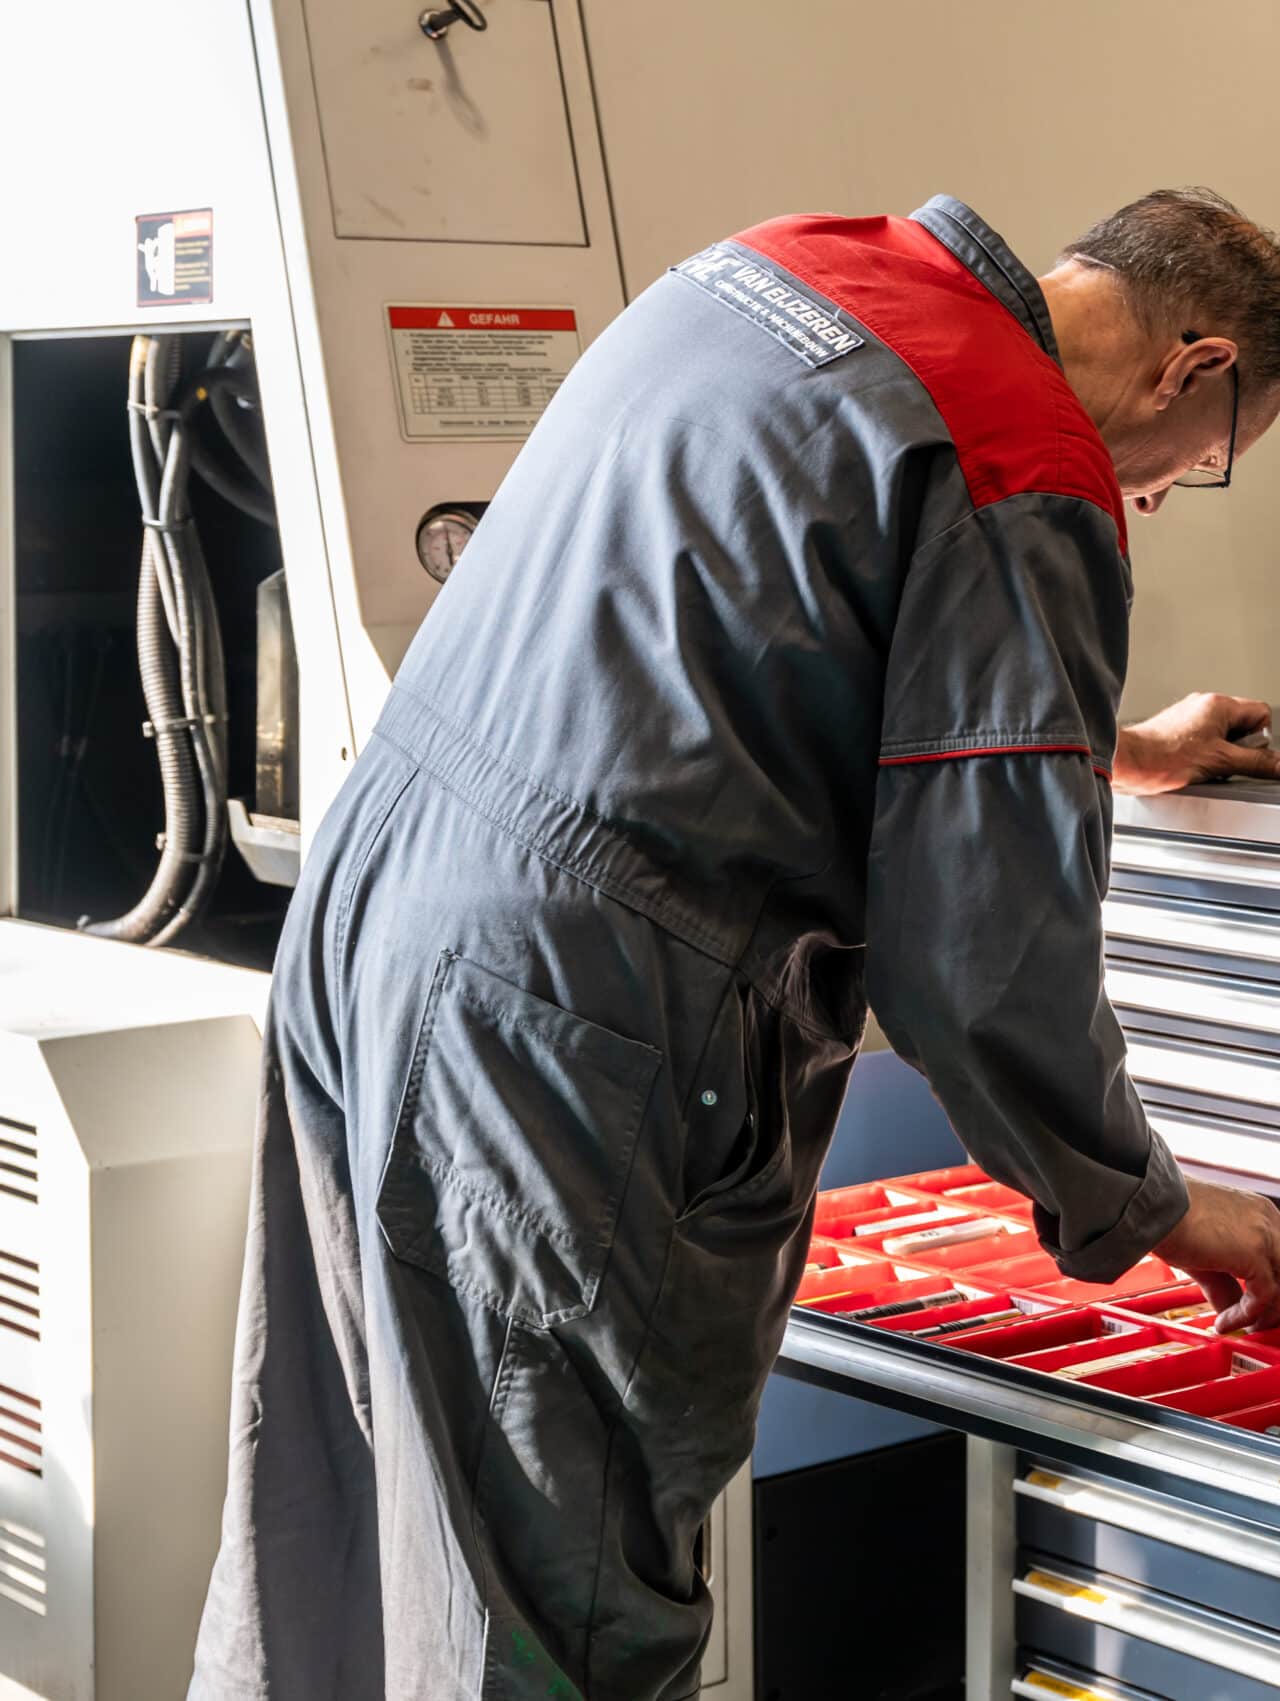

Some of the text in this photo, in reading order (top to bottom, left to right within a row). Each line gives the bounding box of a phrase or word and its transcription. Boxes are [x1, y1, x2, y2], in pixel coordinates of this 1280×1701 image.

[468, 312, 520, 325] GEFAHR
[732, 265, 770, 293] VAN
[762, 286, 856, 351] EIJZEREN
